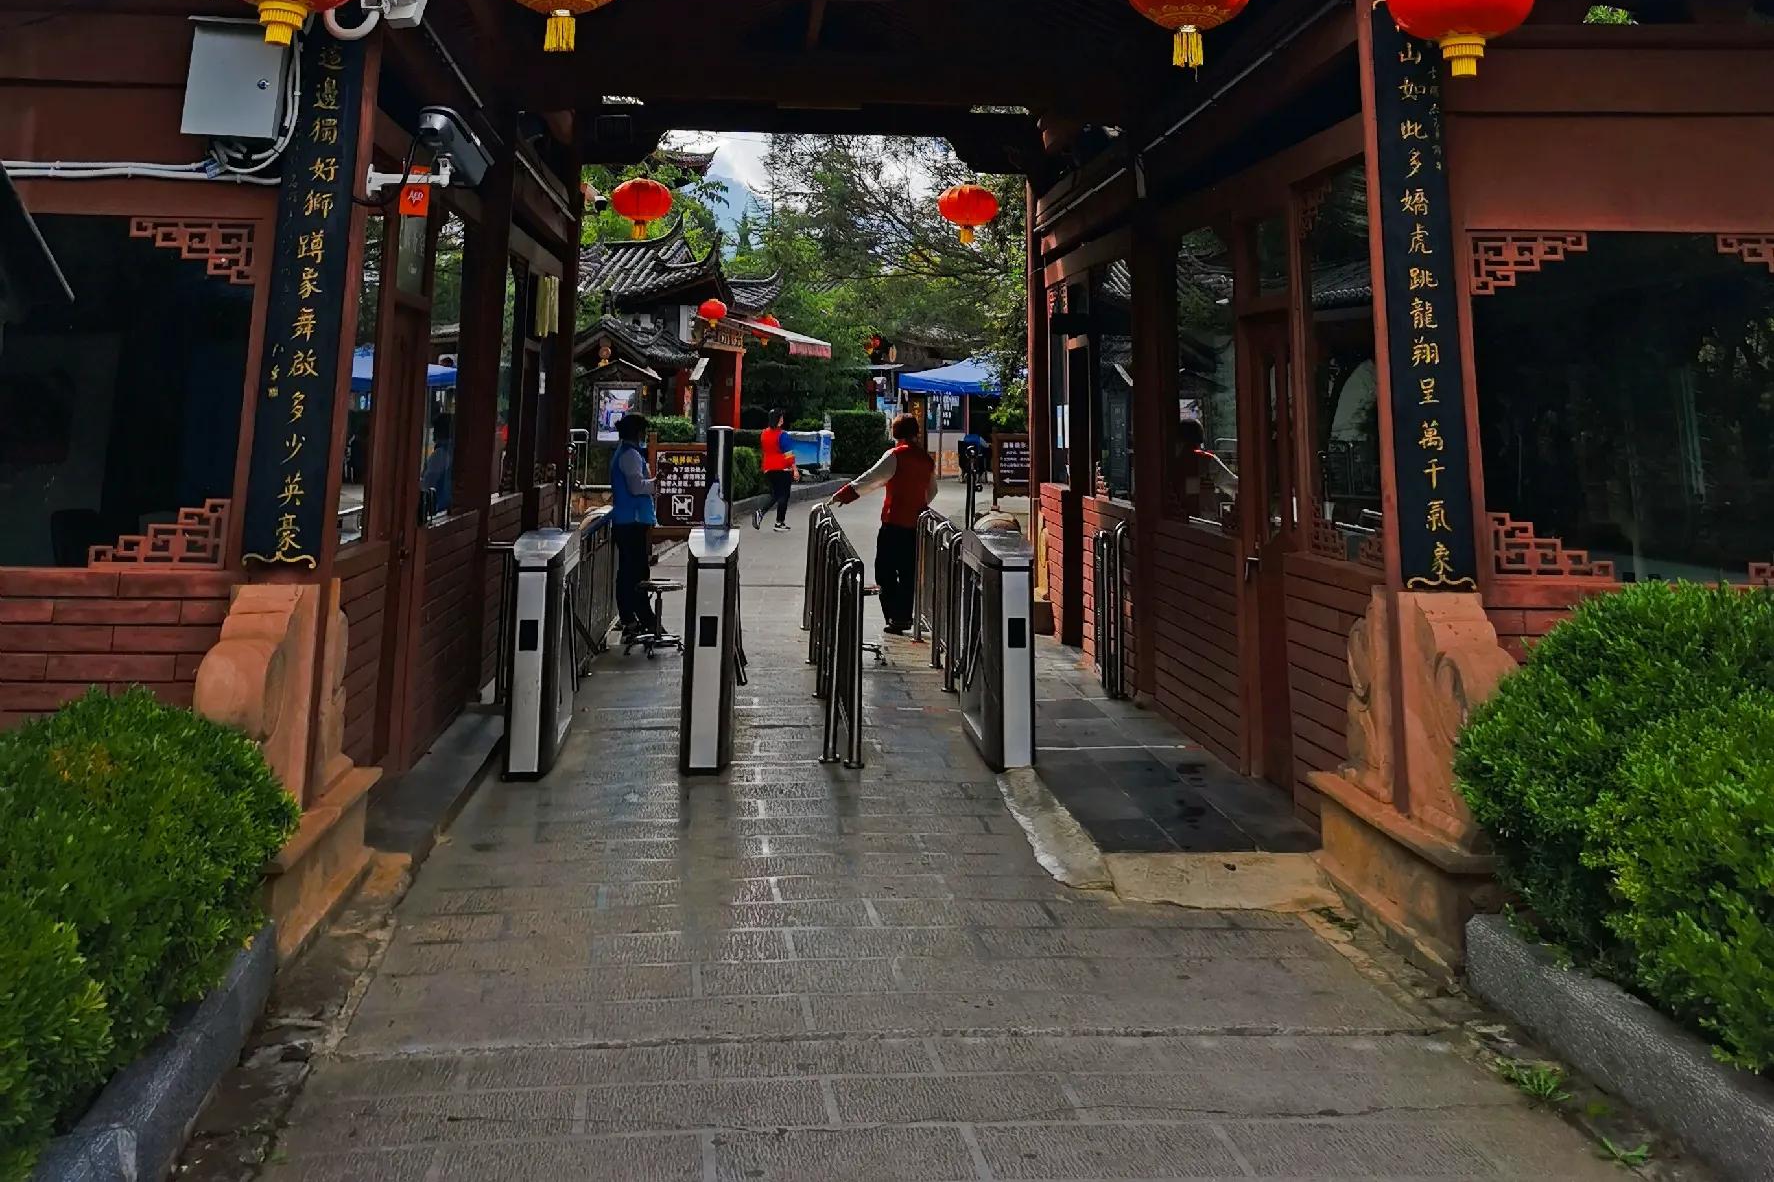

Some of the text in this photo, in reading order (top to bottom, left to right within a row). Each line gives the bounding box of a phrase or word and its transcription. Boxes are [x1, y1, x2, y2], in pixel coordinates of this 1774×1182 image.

[1395, 24, 1454, 574] 山如此多嬌虎跳龍翔呈萬千氣象
